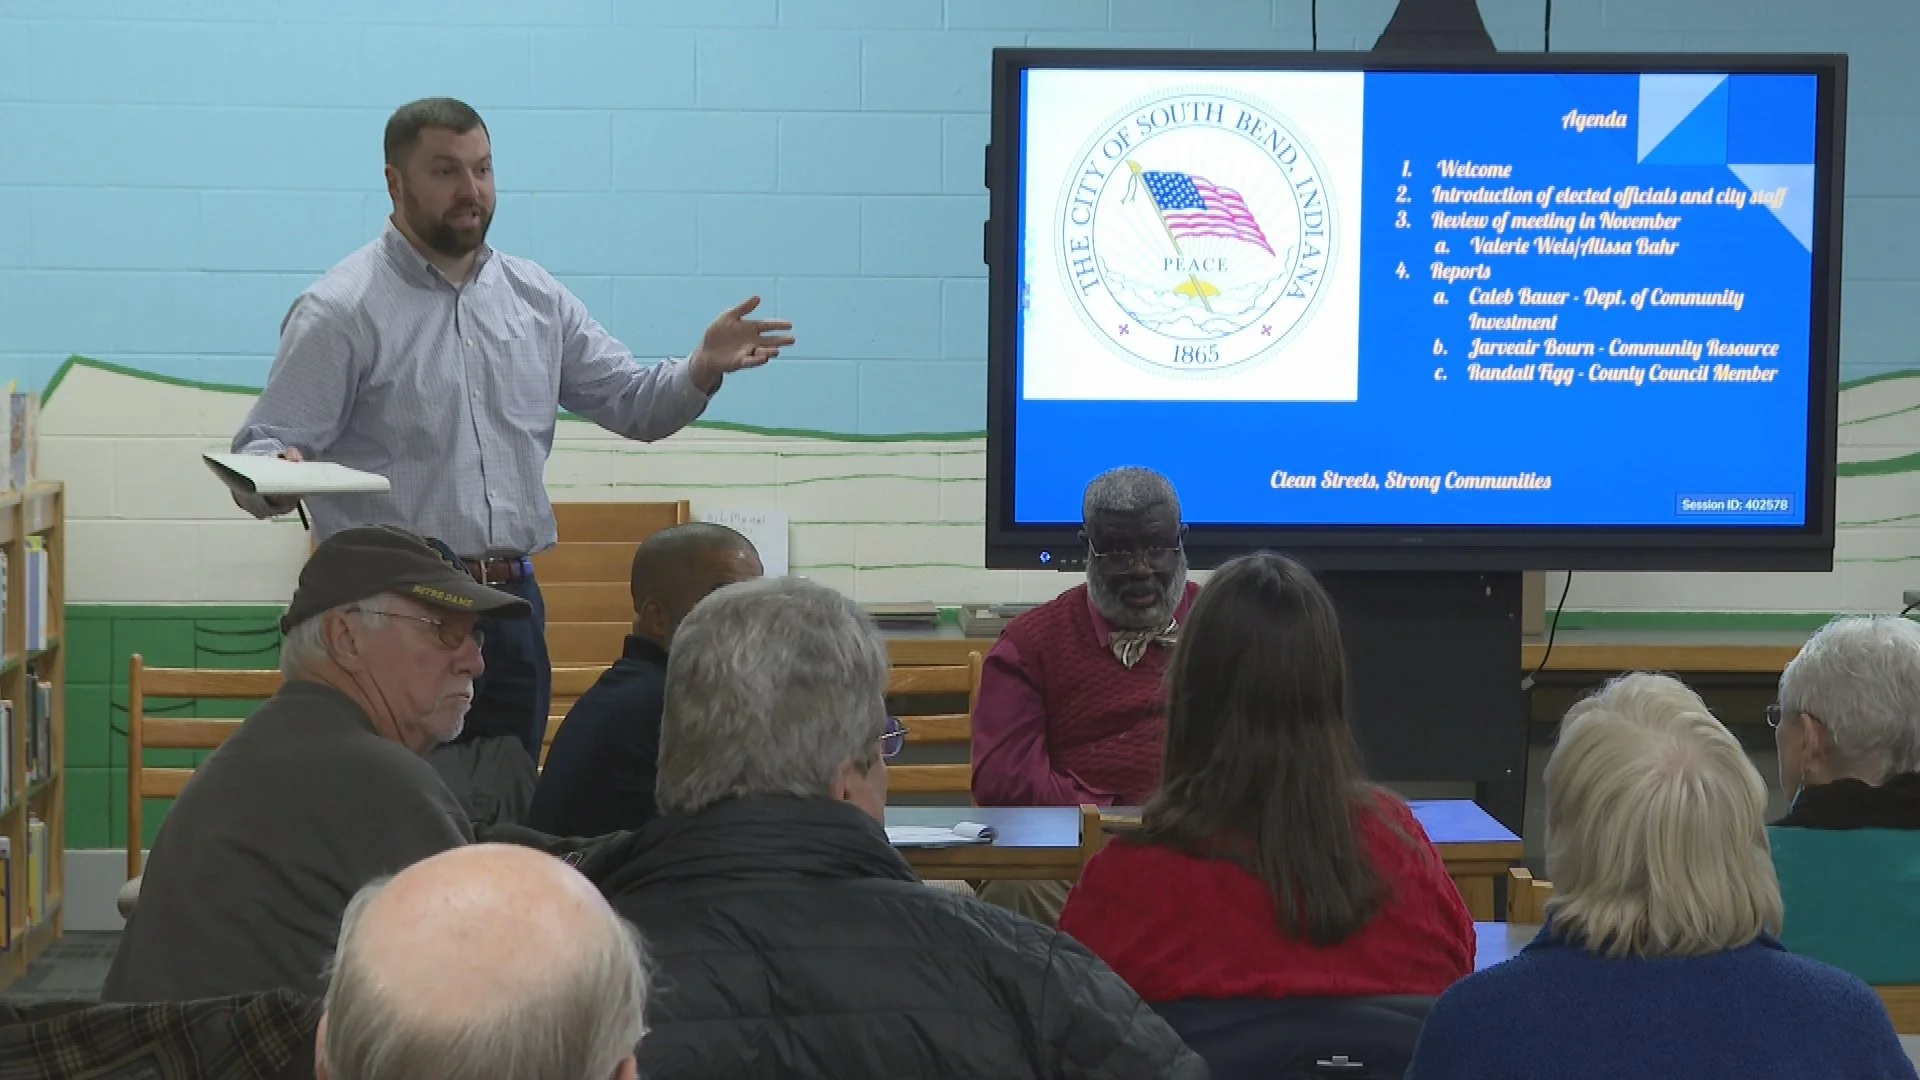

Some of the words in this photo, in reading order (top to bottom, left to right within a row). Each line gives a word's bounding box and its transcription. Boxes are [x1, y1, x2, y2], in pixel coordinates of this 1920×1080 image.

[1136, 101, 1225, 136] SOUTH
[1561, 109, 1628, 133] Agenda
[1102, 126, 1131, 160] OF
[1235, 110, 1298, 173] BEND,
[1402, 159, 1413, 178] 1.
[1437, 159, 1513, 178] Welcome
[1071, 160, 1106, 226] CITY
[1395, 184, 1412, 204] 2.
[1431, 185, 1534, 204] Introduction
[1536, 185, 1554, 208] of
[1555, 186, 1612, 205] elected
[1613, 185, 1678, 209] officials
[1680, 187, 1714, 205] and
[1716, 187, 1747, 210] city
[1749, 187, 1789, 209] staff
[1395, 210, 1412, 229] 3.
[1431, 210, 1490, 229] Review
[1492, 210, 1511, 234] of
[1511, 211, 1577, 234] meeting
[1579, 211, 1597, 230] in
[1599, 211, 1682, 230] November
[1286, 176, 1324, 300] INDIANA
[1434, 240, 1451, 255] a.
[1470, 235, 1530, 255] Valerie
[1636, 236, 1680, 256] Bahr
[1070, 234, 1100, 297] THE
[1163, 257, 1228, 273] PEACE
[1395, 261, 1411, 279] 4.
[1430, 261, 1492, 284] Reports
[1433, 291, 1450, 305] a.
[1468, 286, 1515, 305] Caleb
[1518, 287, 1571, 306] Bauer
[1583, 287, 1627, 311] Dept.
[1630, 287, 1650, 311] of
[1650, 287, 1745, 311] Community
[1468, 312, 1559, 331] Investment
[1173, 343, 1219, 365] 1865
[1433, 338, 1448, 355] b.
[1468, 337, 1541, 360] Jarveair
[1544, 337, 1595, 356] Bourn
[1609, 338, 1703, 361] Community
[1706, 338, 1780, 357] Resource
[1434, 367, 1448, 381] c.
[1467, 363, 1535, 381] Randall
[1538, 363, 1576, 387] Figg
[1589, 363, 1646, 387] County
[1649, 363, 1710, 382] Council
[1713, 363, 1779, 383] Member
[1270, 470, 1317, 489] Clean
[1321, 470, 1380, 491] Streets,
[1384, 470, 1442, 495] Strong
[1445, 470, 1552, 490] Communities
[1682, 498, 1725, 511] Session
[1727, 499, 1743, 511] ID:
[1745, 498, 1789, 511] 402578
